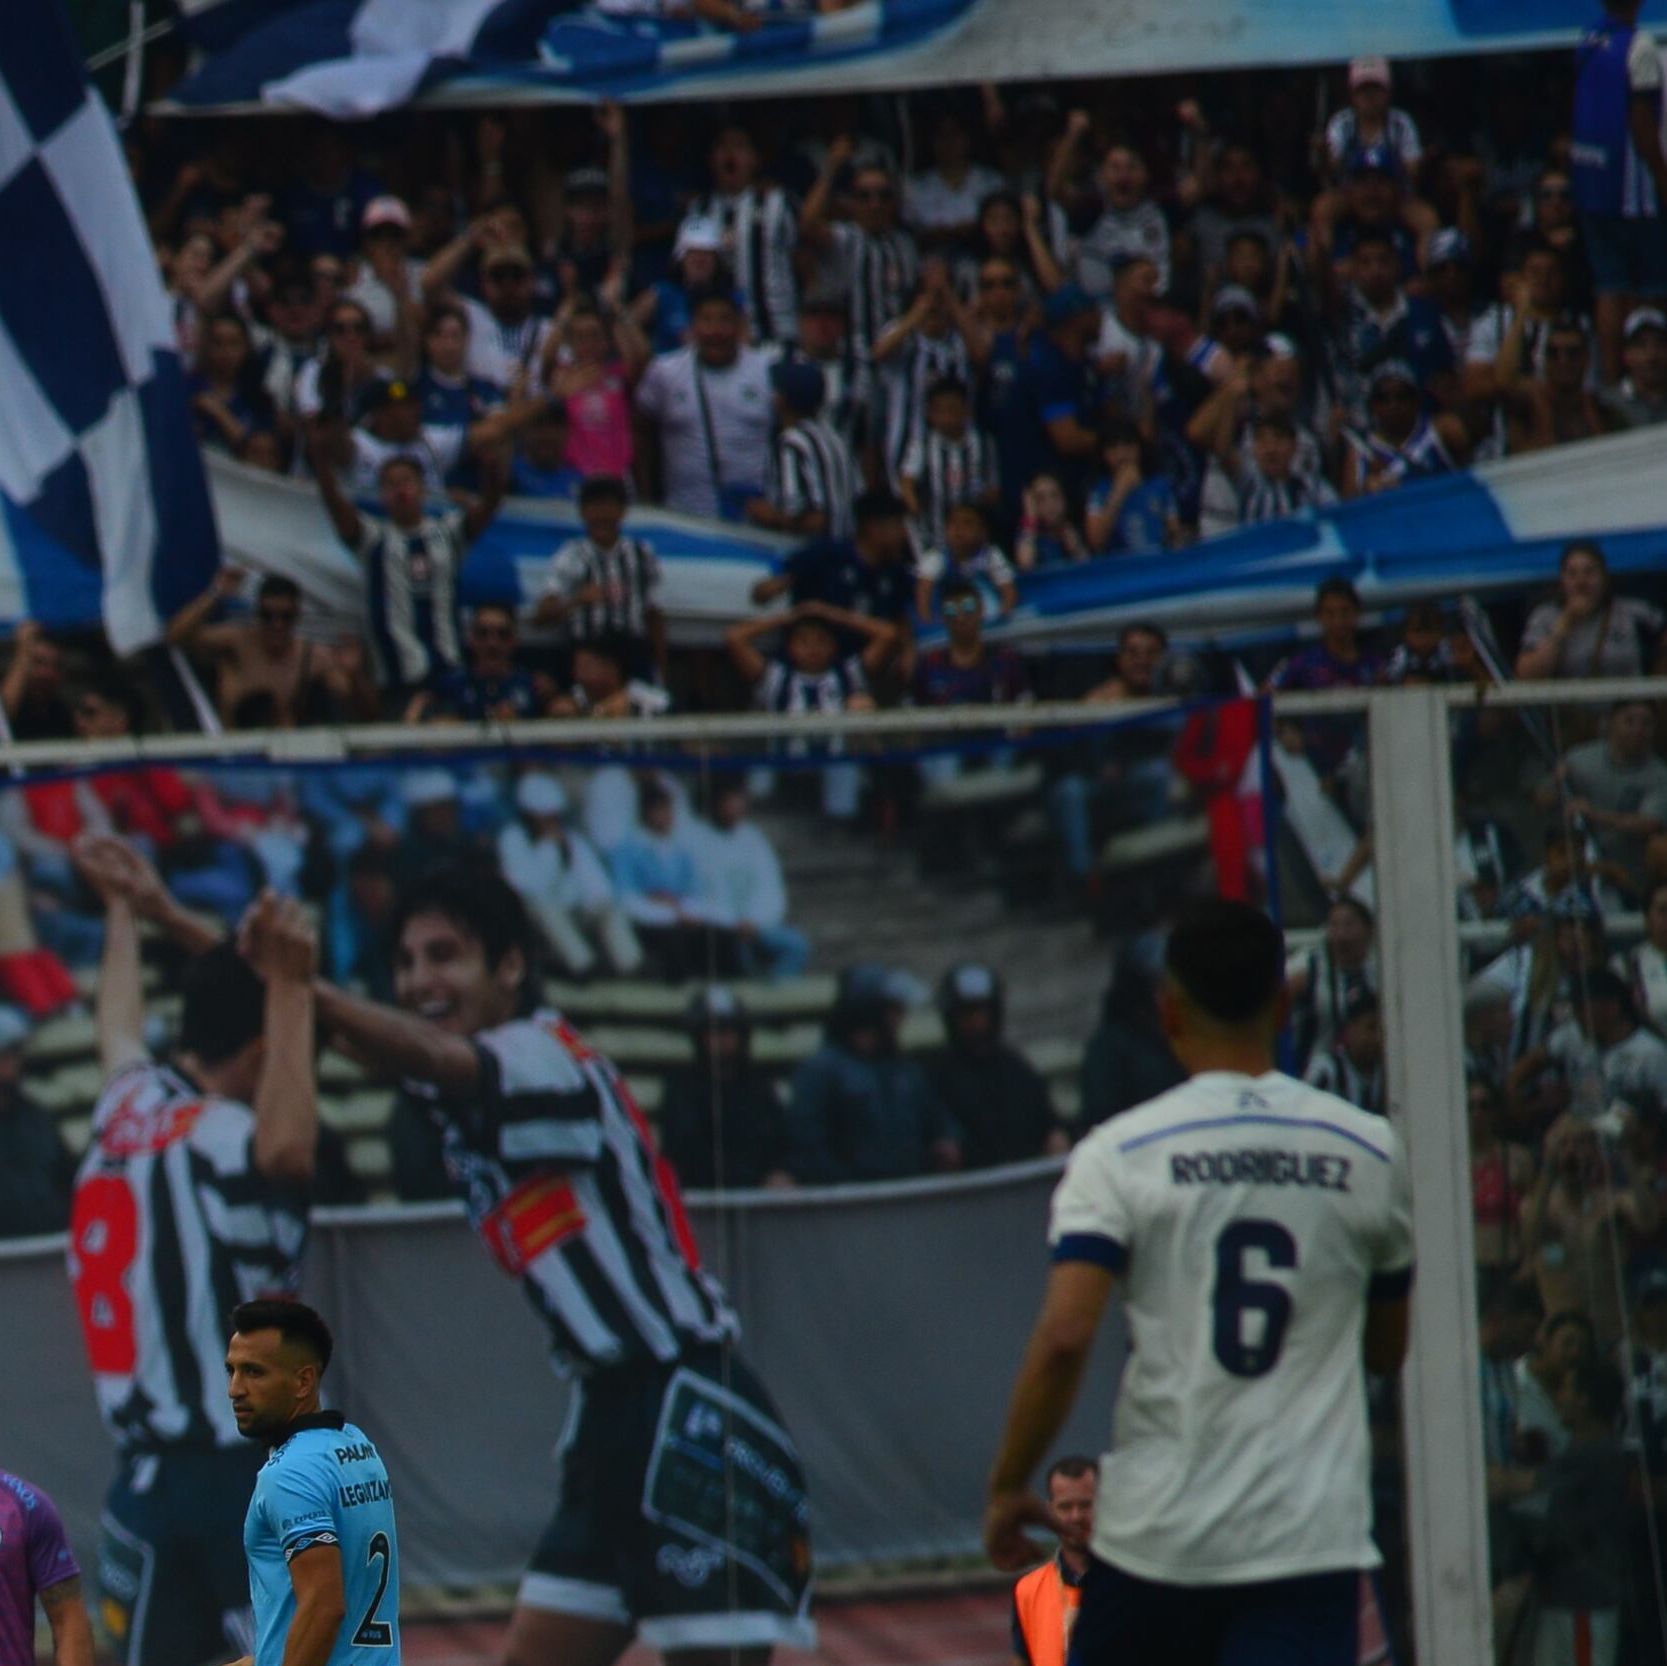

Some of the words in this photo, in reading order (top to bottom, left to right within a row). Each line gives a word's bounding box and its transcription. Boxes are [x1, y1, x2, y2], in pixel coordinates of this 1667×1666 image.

[1171, 1152, 1351, 1192] RODRIGUEZ
[1216, 1219, 1296, 1378] 6
[350, 1530, 394, 1648] 2
